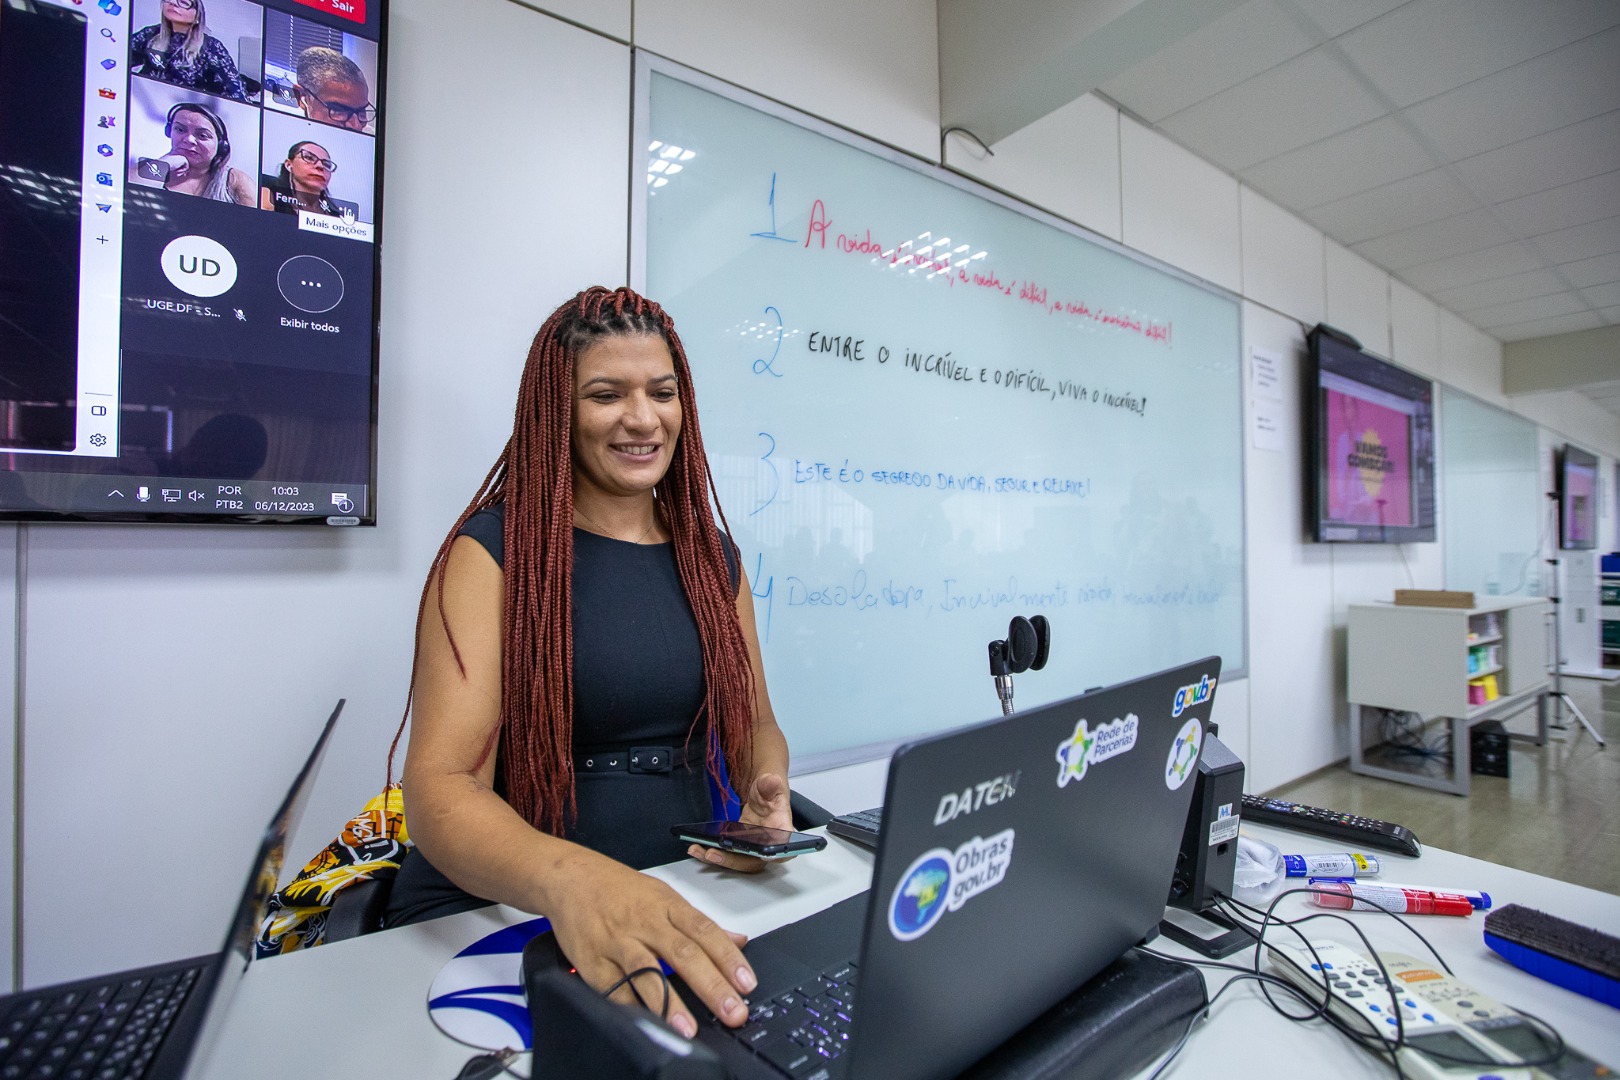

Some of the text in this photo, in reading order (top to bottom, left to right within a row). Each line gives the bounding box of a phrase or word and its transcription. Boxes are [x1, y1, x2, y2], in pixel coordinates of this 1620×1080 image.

[332, 0, 354, 13] Sair
[306, 217, 367, 238] Mais opções
[805, 199, 833, 249] A
[836, 229, 887, 259] vida
[178, 254, 221, 277] UD
[147, 298, 174, 311] UGE
[176, 303, 193, 314] DF
[280, 316, 340, 333] Exibir todos
[807, 331, 866, 362] ENTRE
[877, 345, 890, 364] O
[217, 485, 242, 496] POR
[271, 486, 300, 496] 10:03
[215, 499, 244, 510] PTB2
[254, 501, 315, 512] 06/12/2023
[1173, 676, 1215, 716] gov.br
[1097, 720, 1135, 743] Rede de
[1094, 734, 1134, 758] Parcerias
[955, 837, 1009, 875] Obras
[953, 860, 1006, 905] gov.br
